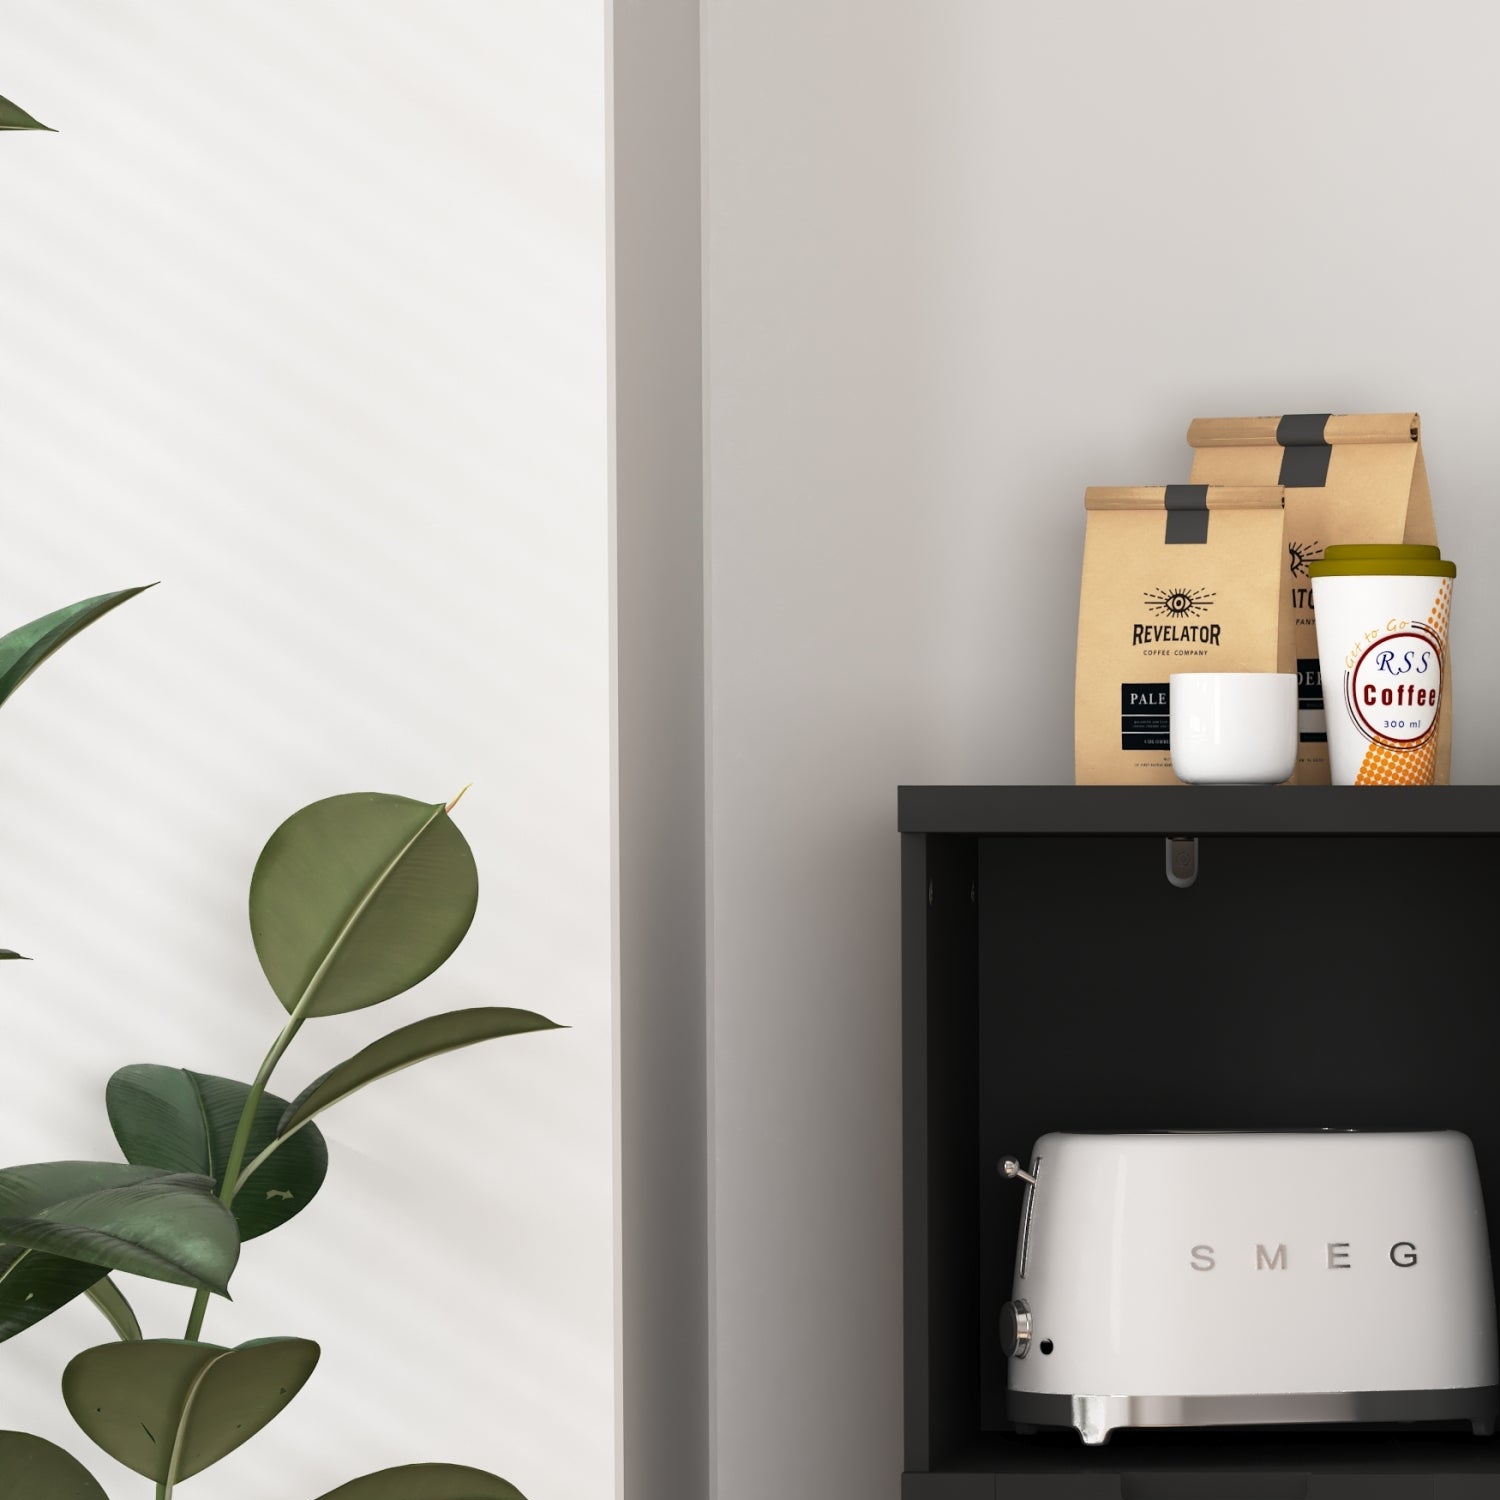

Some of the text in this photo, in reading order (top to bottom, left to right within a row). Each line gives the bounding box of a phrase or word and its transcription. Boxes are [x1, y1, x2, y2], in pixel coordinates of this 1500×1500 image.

[1133, 624, 1221, 646] REVELATOR
[1345, 618, 1409, 669] Get to Go
[1376, 650, 1431, 676] RSS
[1130, 692, 1167, 705] PALE
[1363, 684, 1436, 706] Coffee
[1384, 720, 1421, 728] 300 ml
[1190, 1242, 1418, 1272] SMEG
